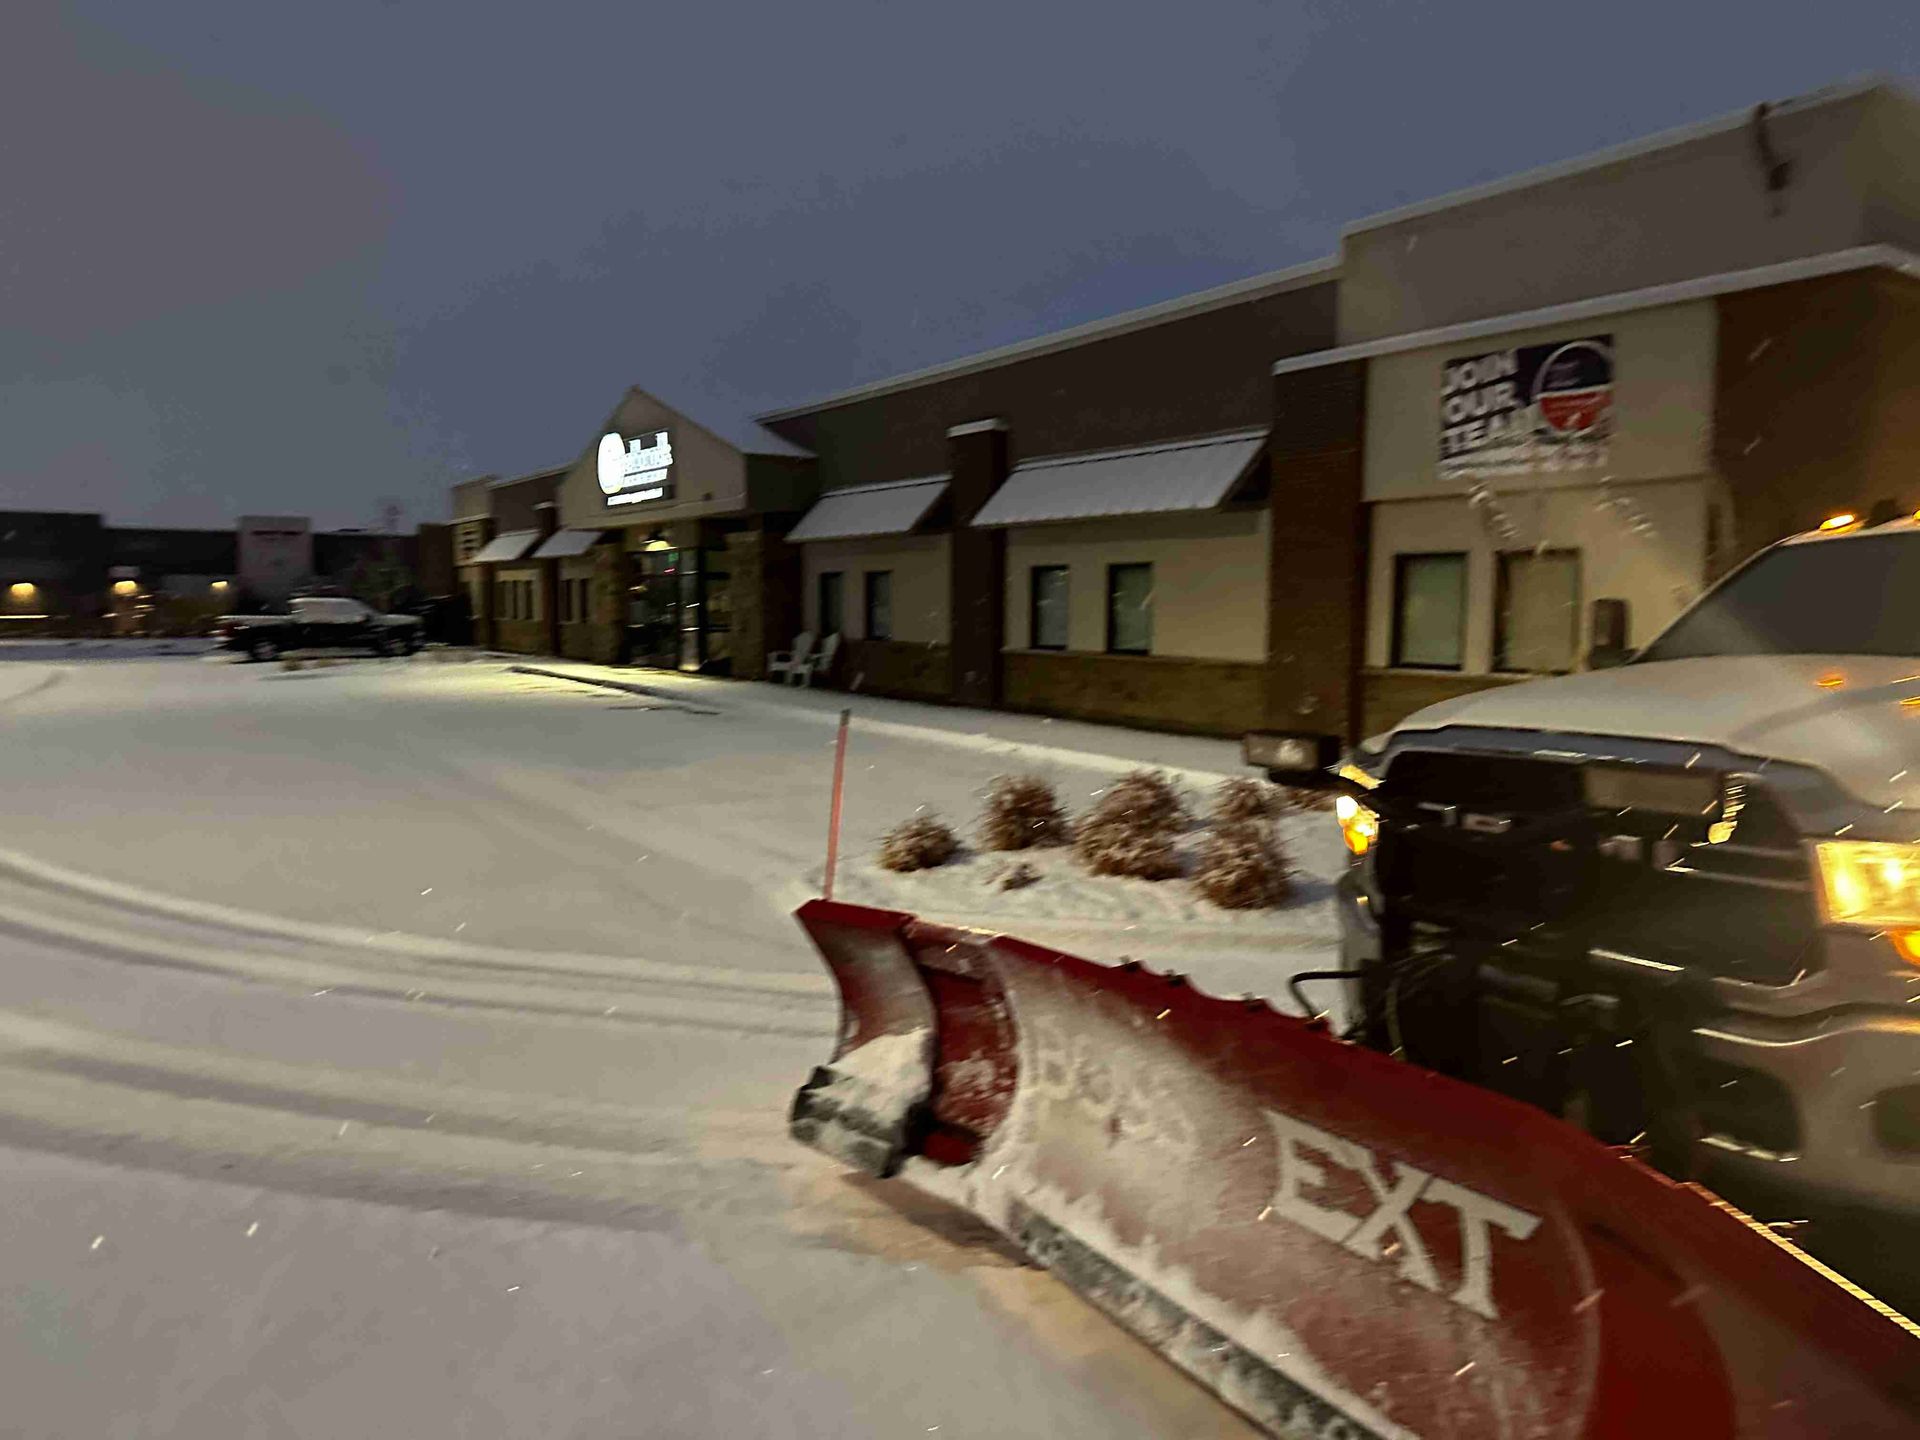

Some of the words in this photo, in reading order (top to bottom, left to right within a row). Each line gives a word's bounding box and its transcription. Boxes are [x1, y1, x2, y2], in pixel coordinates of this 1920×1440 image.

[1441, 350, 1519, 397] JOIN
[1445, 380, 1522, 425] OUR
[1439, 405, 1543, 456] TEA
[1263, 1109, 1543, 1319] EXT
